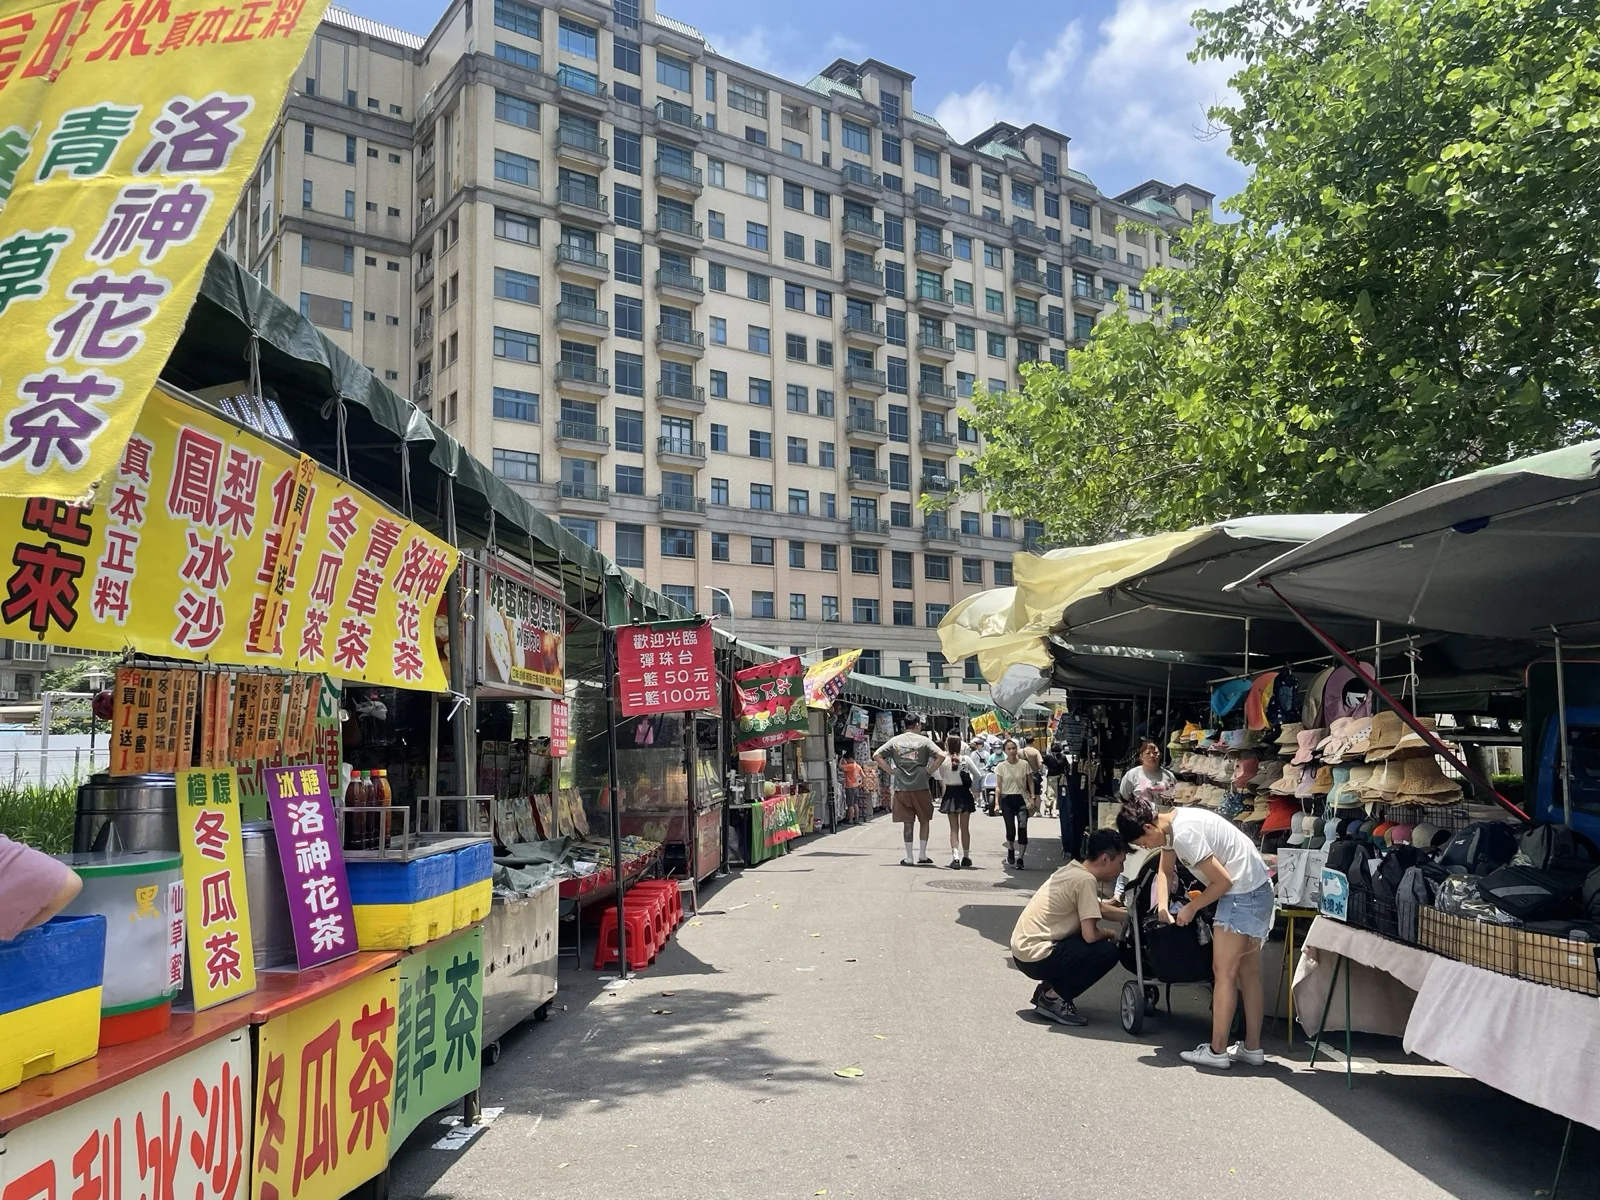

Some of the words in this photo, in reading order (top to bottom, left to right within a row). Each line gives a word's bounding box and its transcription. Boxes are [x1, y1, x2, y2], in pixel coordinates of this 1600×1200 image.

[156, 0, 302, 55] 真本正料
[0, 96, 250, 466] 洛神花茶
[94, 437, 153, 622] 真本正料
[169, 429, 261, 648] 鳳梨冰沙
[300, 496, 360, 662] 冬瓜茶
[334, 517, 400, 669] 青草茶
[393, 537, 449, 681] 洛神花茶
[633, 630, 698, 649] 歡迎光臨
[640, 649, 693, 668] 彈珠台
[665, 669, 689, 685] 50
[693, 667, 709, 683] 元
[187, 773, 232, 806] 檸檬
[276, 769, 321, 798] 冰糖
[170, 885, 184, 985] 仙草蜜
[193, 810, 242, 990] 冬瓜茶
[287, 801, 346, 954] 洛神花茶
[2, 1060, 243, 1200] 冰沙
[257, 997, 396, 1200] 冬瓜茶
